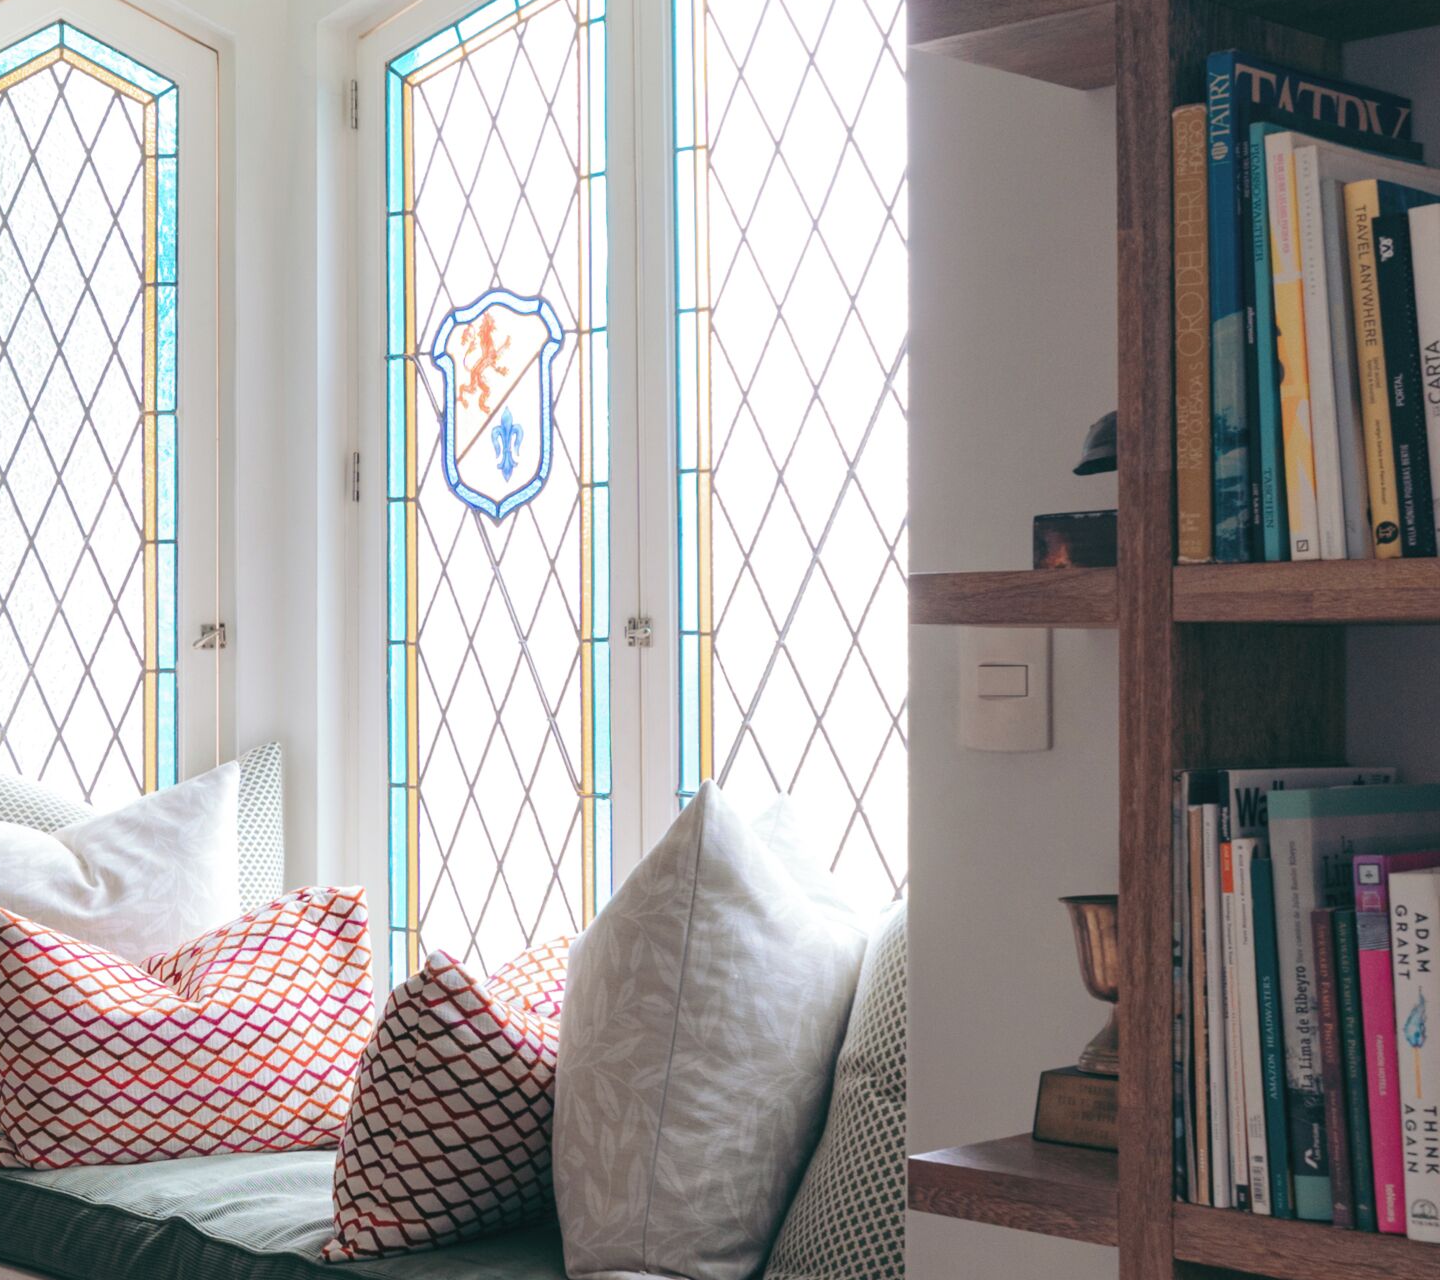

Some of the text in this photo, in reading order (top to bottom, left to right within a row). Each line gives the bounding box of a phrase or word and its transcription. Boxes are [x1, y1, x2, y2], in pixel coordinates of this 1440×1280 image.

[1209, 71, 1231, 141] TATRY
[1189, 120, 1204, 175] HIDALGO
[1176, 178, 1205, 357] ORO DEL PERU
[1354, 204, 1377, 347] TRAVEL ANYWHERE
[1394, 373, 1406, 407] PORTAL
[1264, 468, 1274, 529] TASCHEN
[1395, 904, 1410, 980] GRANT
[1415, 912, 1431, 973] ADAM
[1263, 975, 1278, 1099] AMAZON HEADWATERS
[1295, 966, 1314, 1088] La Lima de Ribeyro
[1376, 1034, 1387, 1096] FASHION HOTELS
[1404, 1104, 1419, 1173] AGAIN
[1423, 1105, 1440, 1175] THINK
